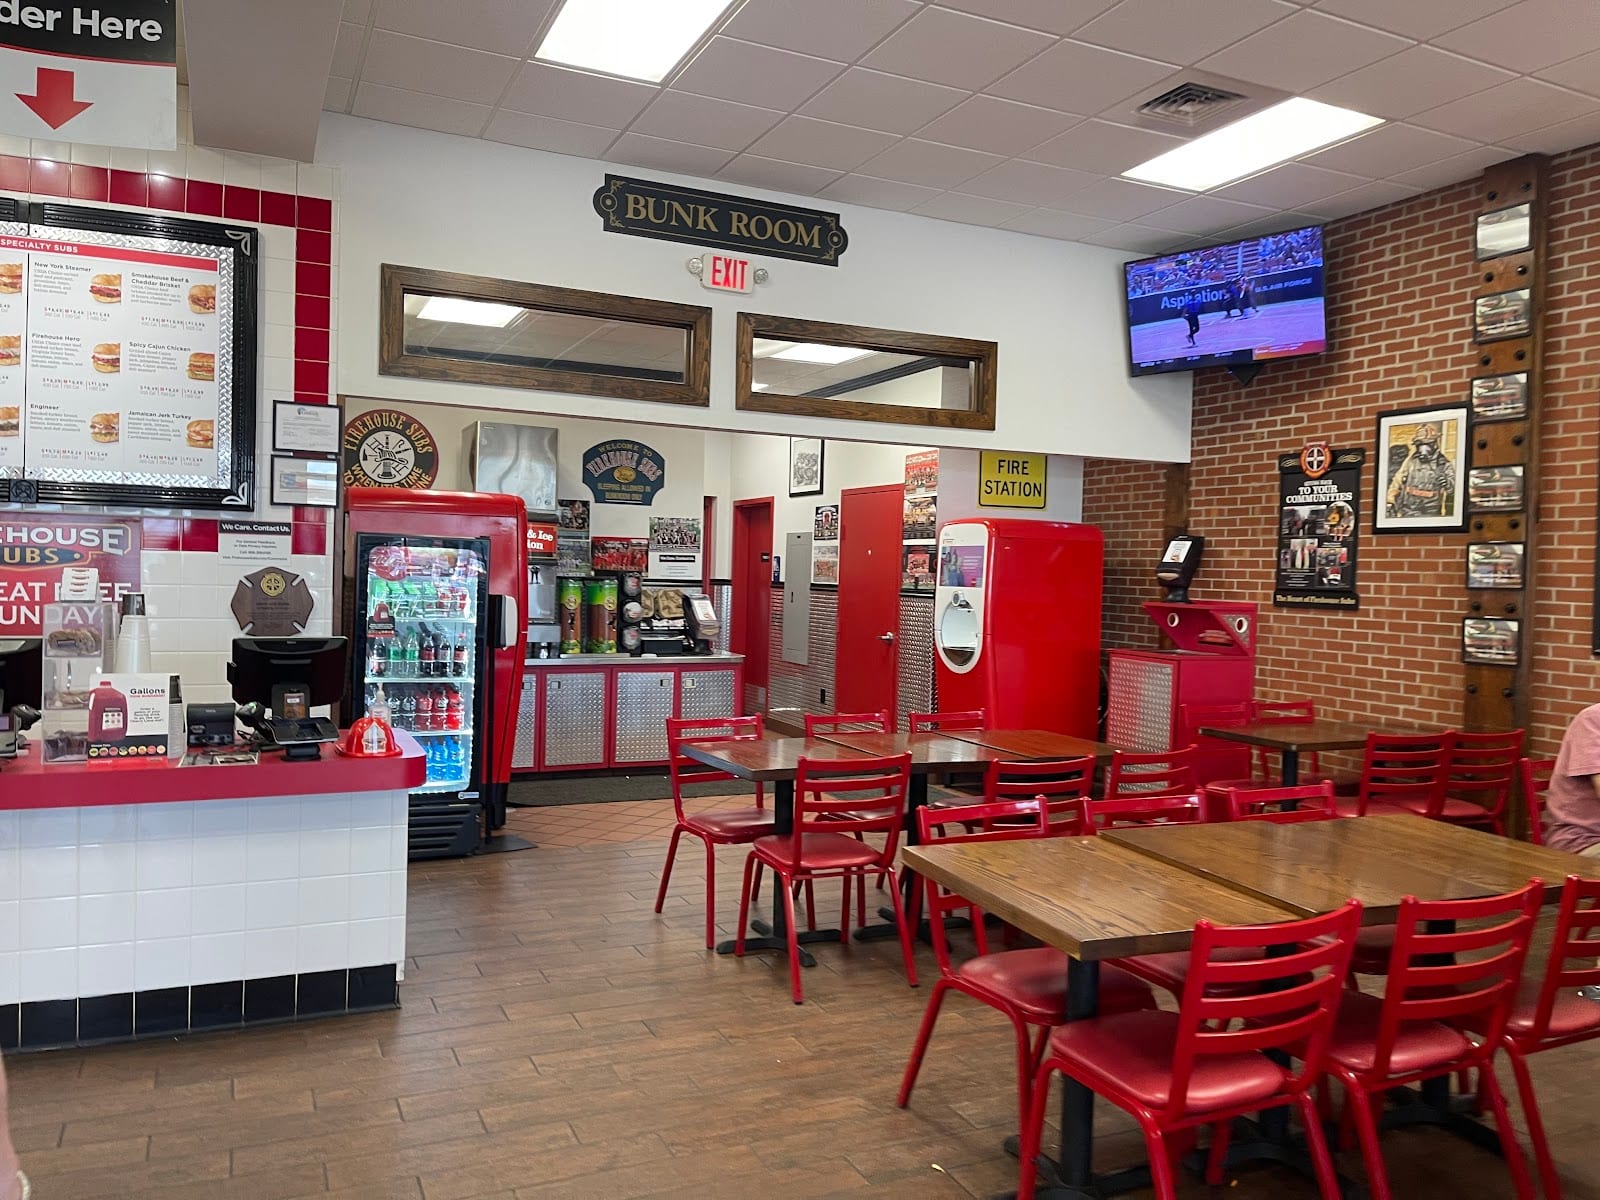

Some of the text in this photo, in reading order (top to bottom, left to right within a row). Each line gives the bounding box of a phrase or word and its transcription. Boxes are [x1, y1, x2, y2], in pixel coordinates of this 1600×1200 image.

[72, 7, 162, 42] Here
[624, 193, 822, 249] BUNK ROOM
[0, 238, 78, 253] SPECIALTY SUBS
[131, 272, 169, 281] Smokehouse
[711, 256, 748, 290] EXIT
[131, 278, 158, 286] Cheddar
[343, 412, 407, 451] FIREHOUSE
[406, 423, 433, 454] SUBS
[997, 459, 1029, 476] FIRE
[401, 466, 423, 488] TIME
[984, 479, 1042, 498] STATION
[1298, 485, 1338, 494] TO YOUR
[1285, 492, 1353, 503] COMMUNITIES
[252, 524, 280, 532] Contact
[537, 530, 554, 541] Ice
[0, 526, 124, 556] HOUSE
[3, 547, 59, 563] UBS
[130, 687, 165, 695] Gallons
